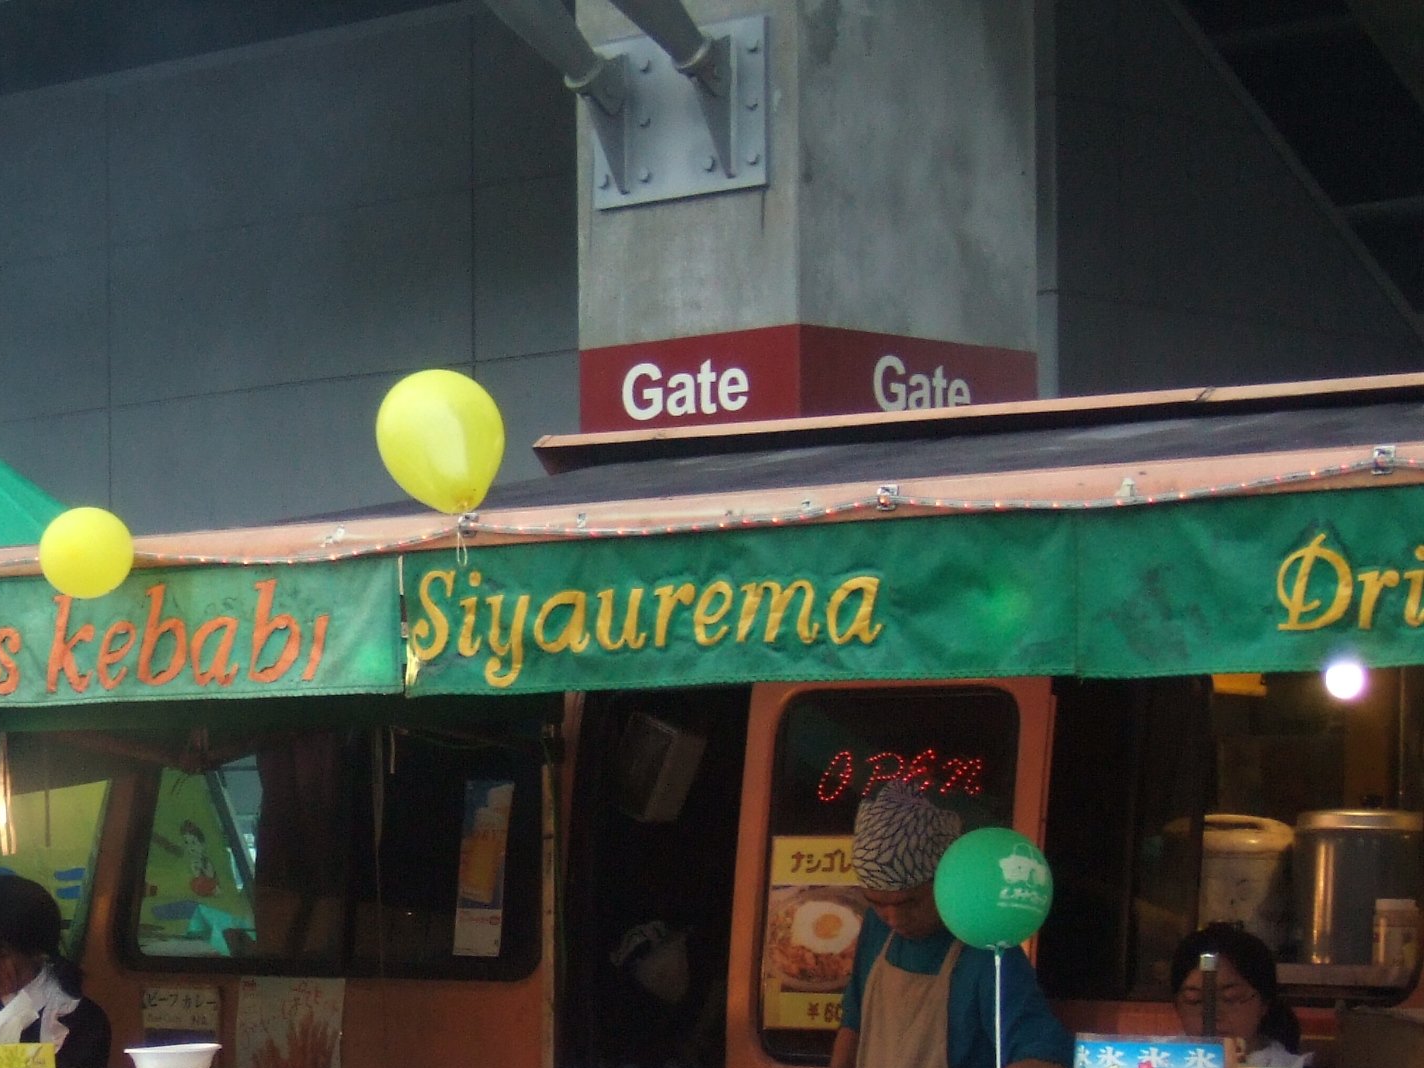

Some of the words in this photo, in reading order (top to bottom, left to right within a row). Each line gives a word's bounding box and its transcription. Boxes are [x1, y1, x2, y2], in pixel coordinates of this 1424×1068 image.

[621, 358, 750, 421] Gate
[874, 354, 972, 412] Gate
[411, 568, 885, 688] Siyaurema
[790, 849, 853, 874] ナシゴレ
